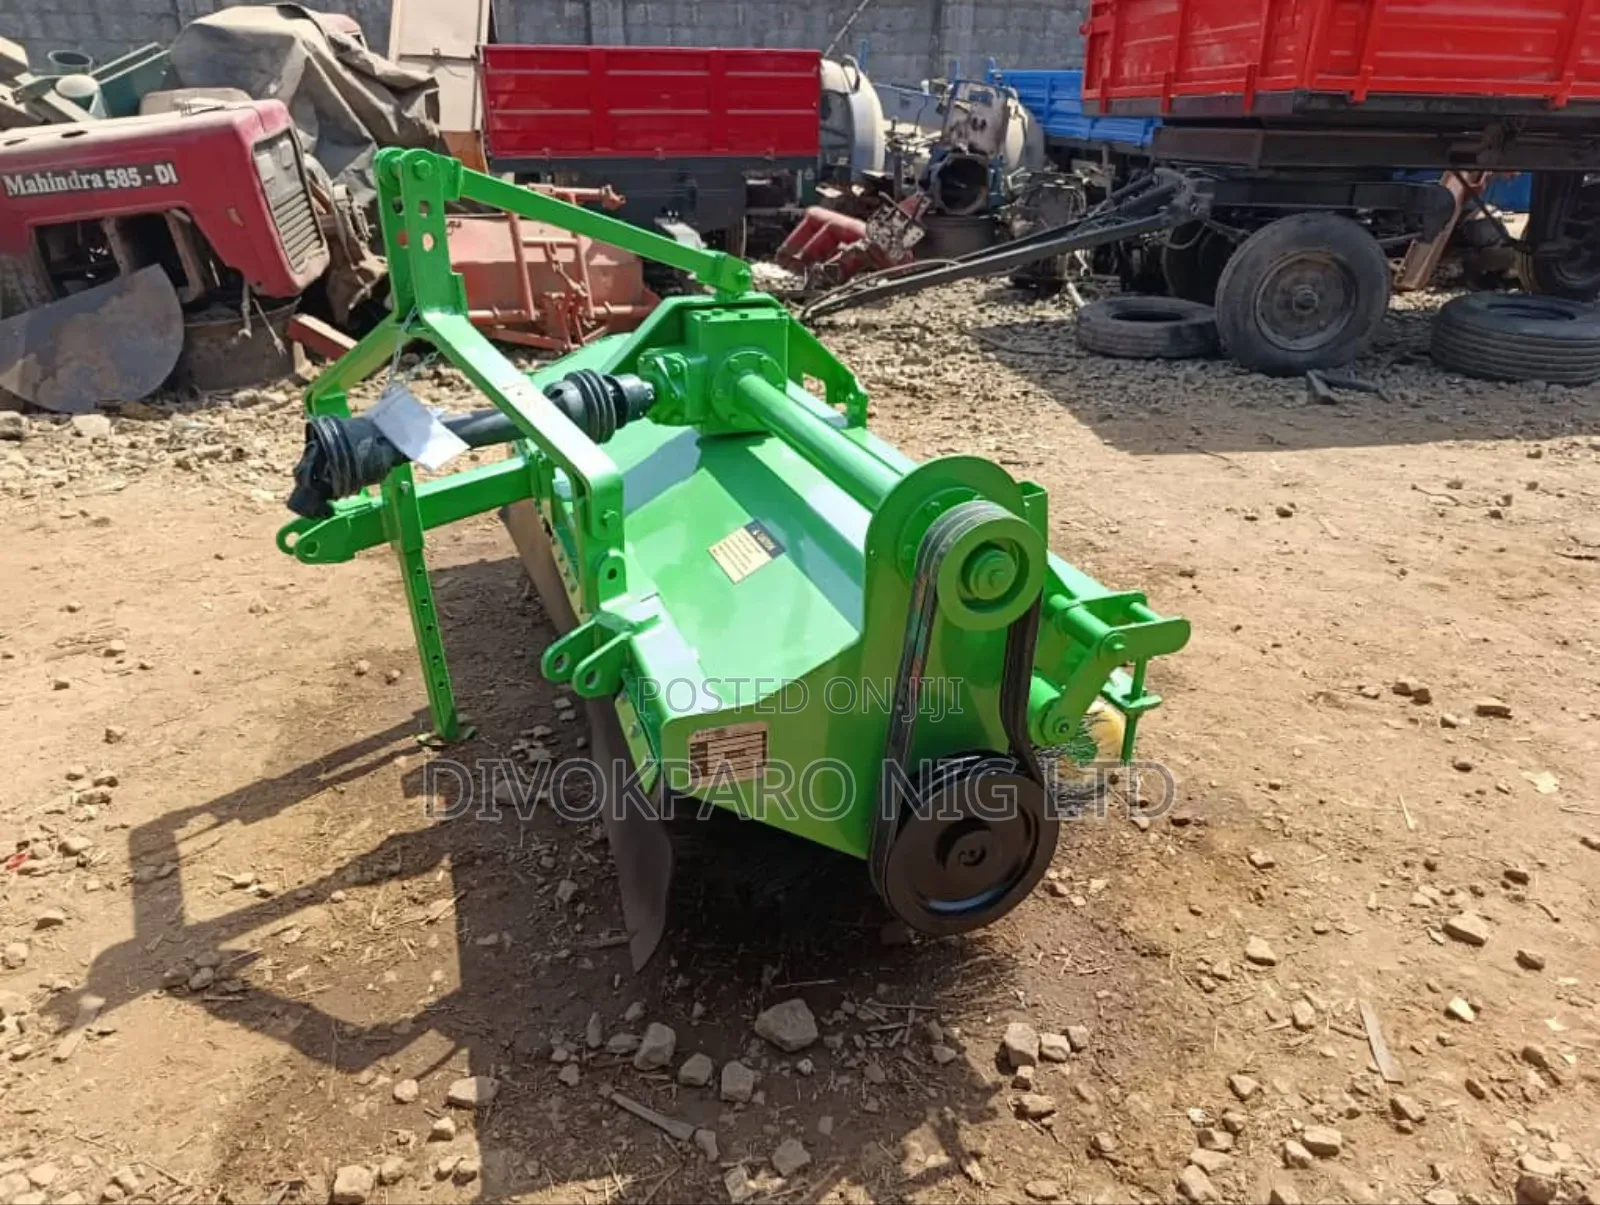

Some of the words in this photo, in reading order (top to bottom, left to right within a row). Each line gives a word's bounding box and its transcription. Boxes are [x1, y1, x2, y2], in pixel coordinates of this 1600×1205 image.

[3, 170, 104, 196] Mahindra
[105, 167, 142, 189] 585
[154, 163, 178, 184] DI
